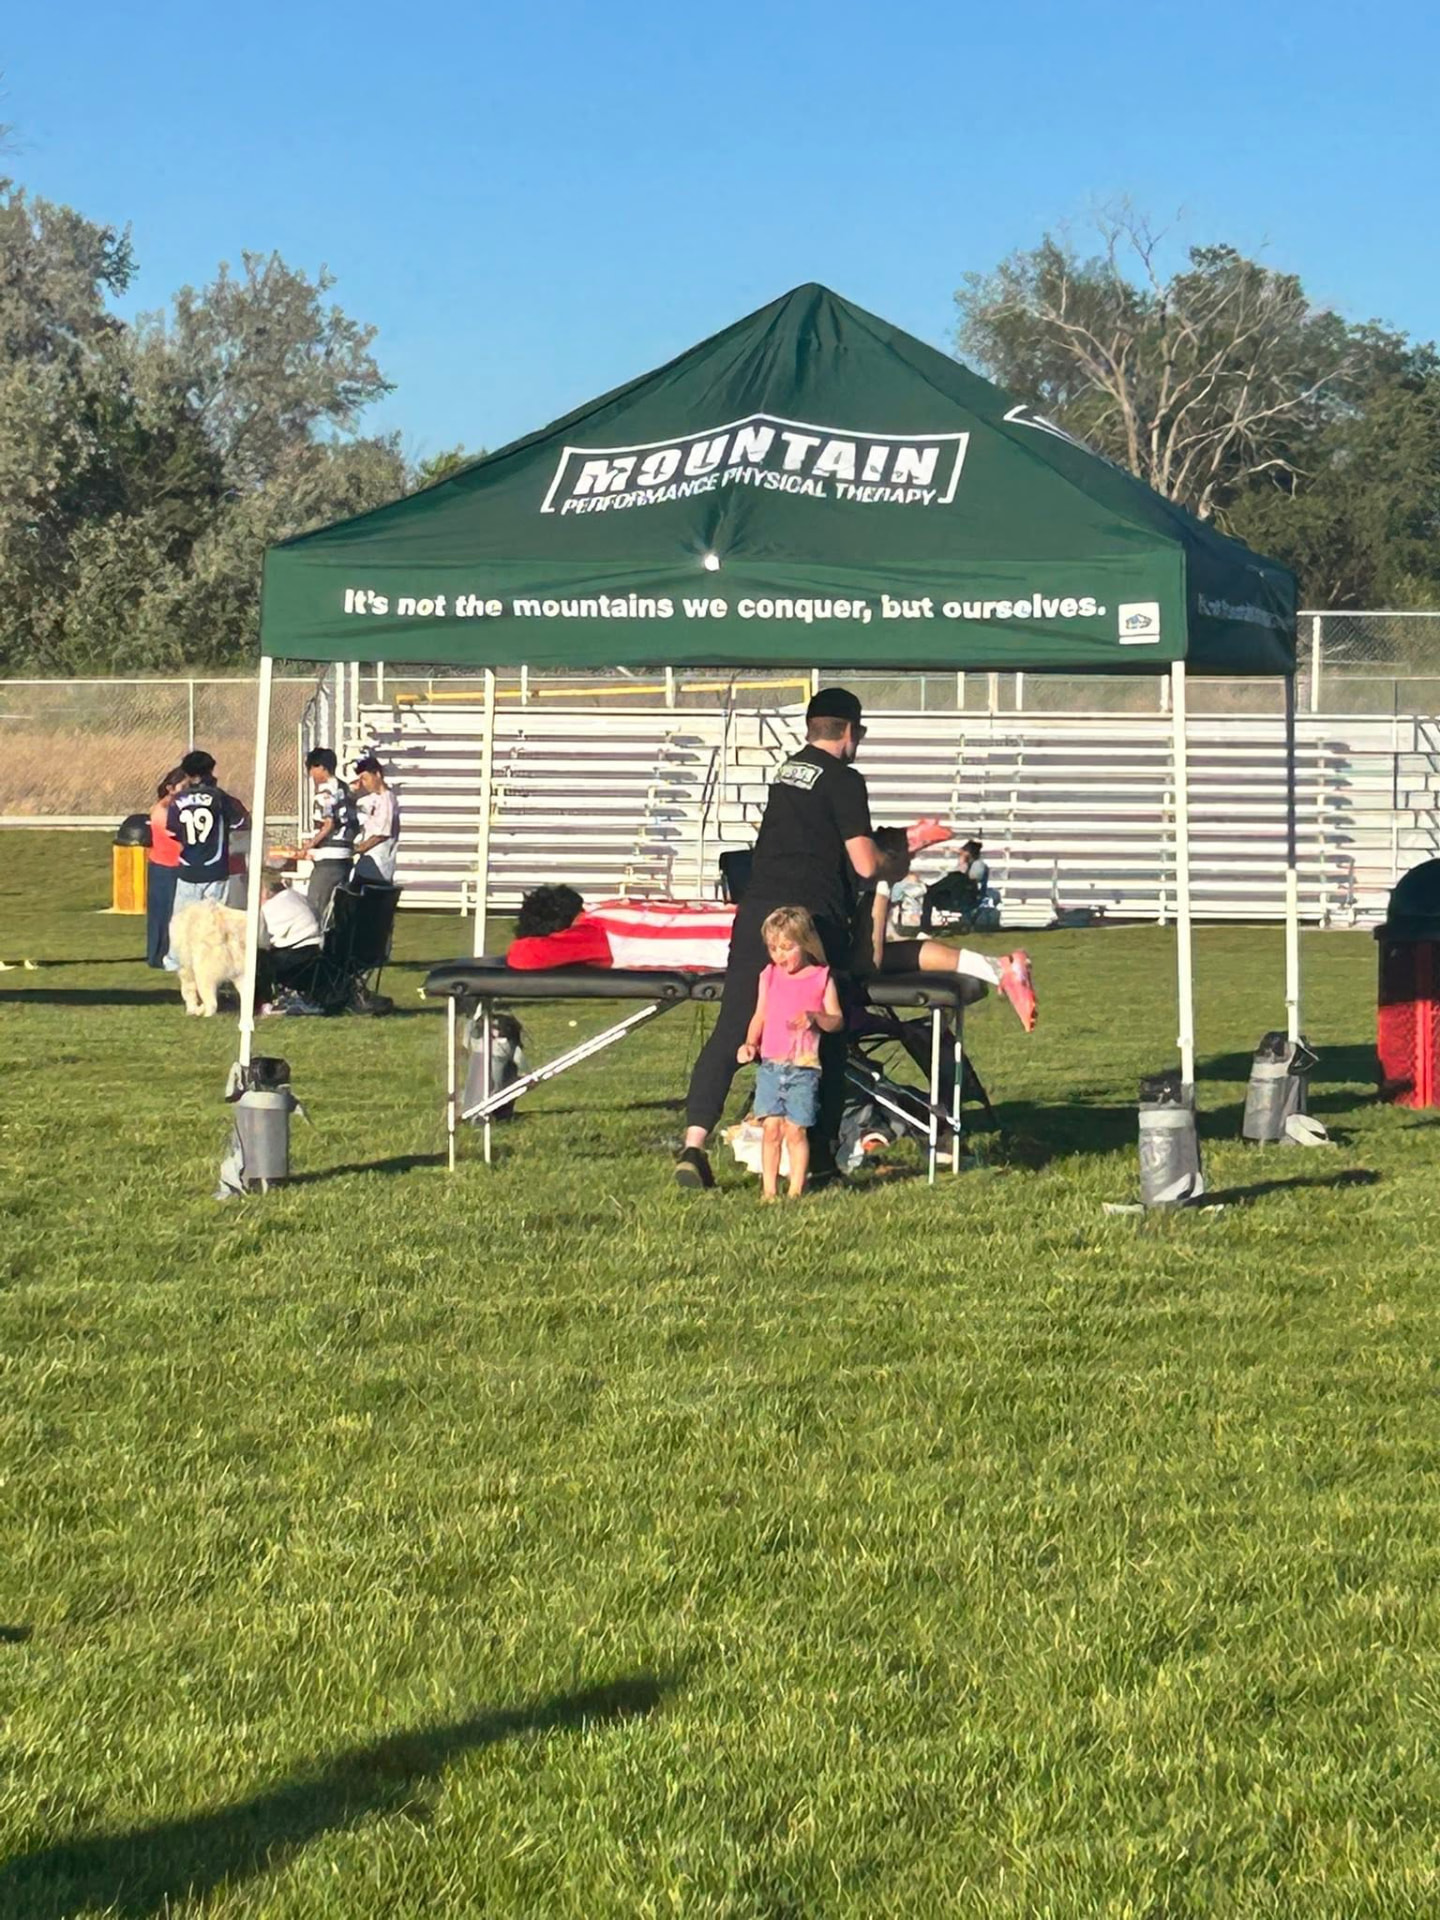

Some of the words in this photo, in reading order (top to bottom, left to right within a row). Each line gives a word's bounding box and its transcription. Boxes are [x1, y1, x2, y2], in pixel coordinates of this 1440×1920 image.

[572, 426, 939, 495] MOUNTAIN
[560, 473, 718, 515] PERFORMANCE
[721, 467, 828, 499] PHYSICAL
[835, 483, 937, 506] THERAPY
[344, 588, 389, 615] It's
[397, 594, 446, 617] not
[455, 593, 503, 617] the
[513, 593, 675, 619] mountains
[683, 598, 728, 618] we
[737, 598, 872, 624] conquer,
[881, 594, 935, 619] but
[942, 593, 1107, 619] ourselves.
[179, 807, 214, 845] 19
